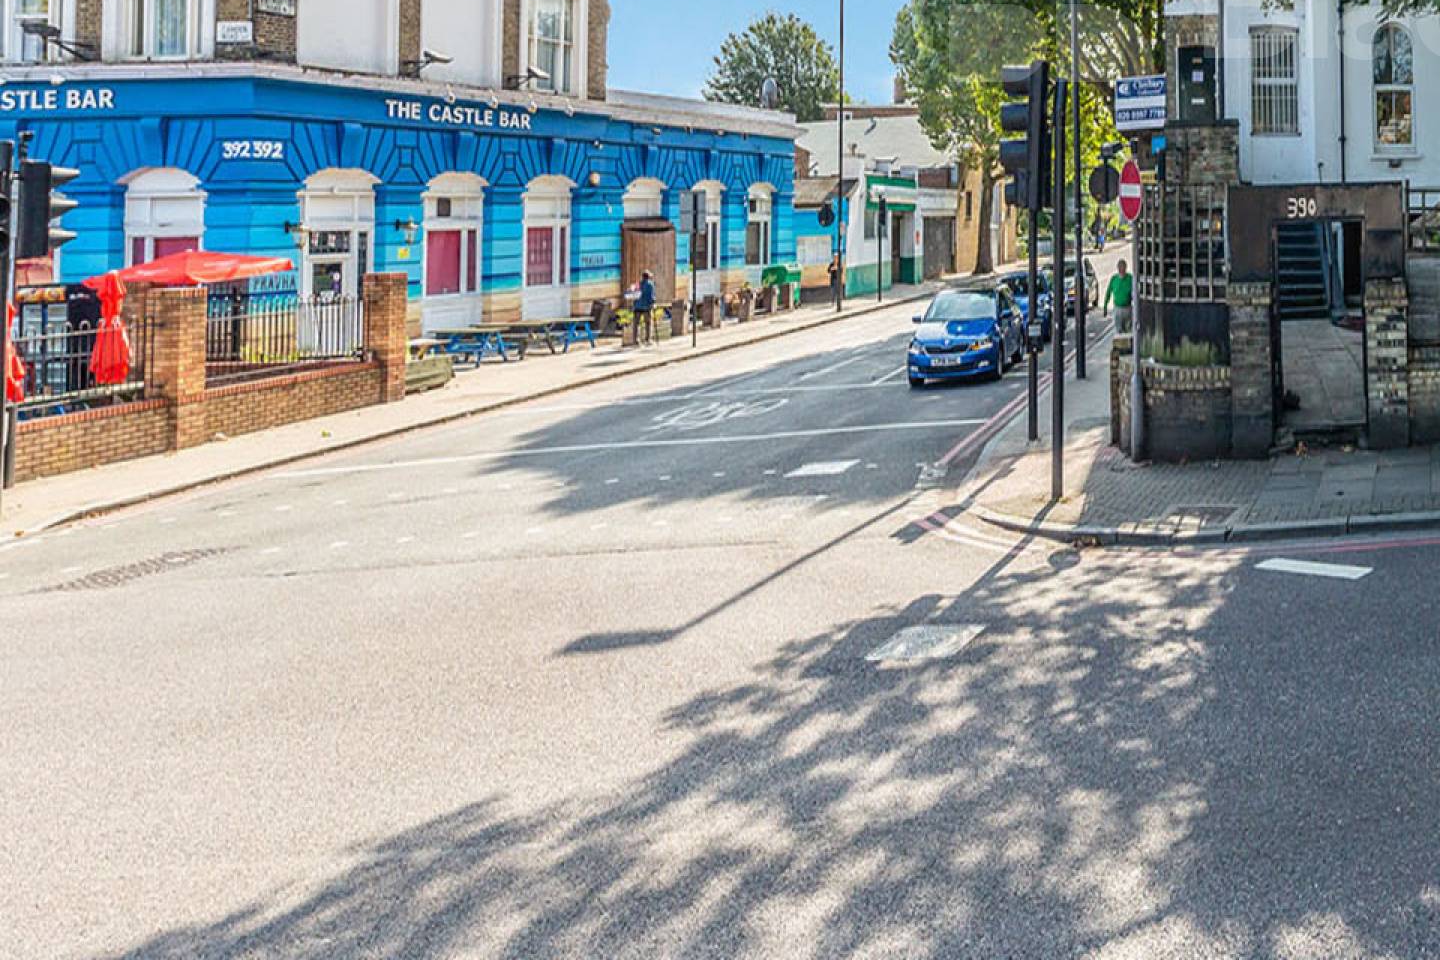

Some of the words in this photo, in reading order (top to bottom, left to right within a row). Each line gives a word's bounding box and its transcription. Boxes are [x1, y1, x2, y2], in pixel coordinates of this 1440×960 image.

[66, 89, 114, 109] BAR
[385, 99, 421, 120] THE
[429, 104, 493, 126] CASTLE
[499, 111, 531, 130] BAR
[223, 140, 250, 159] 392
[253, 140, 283, 159] 392
